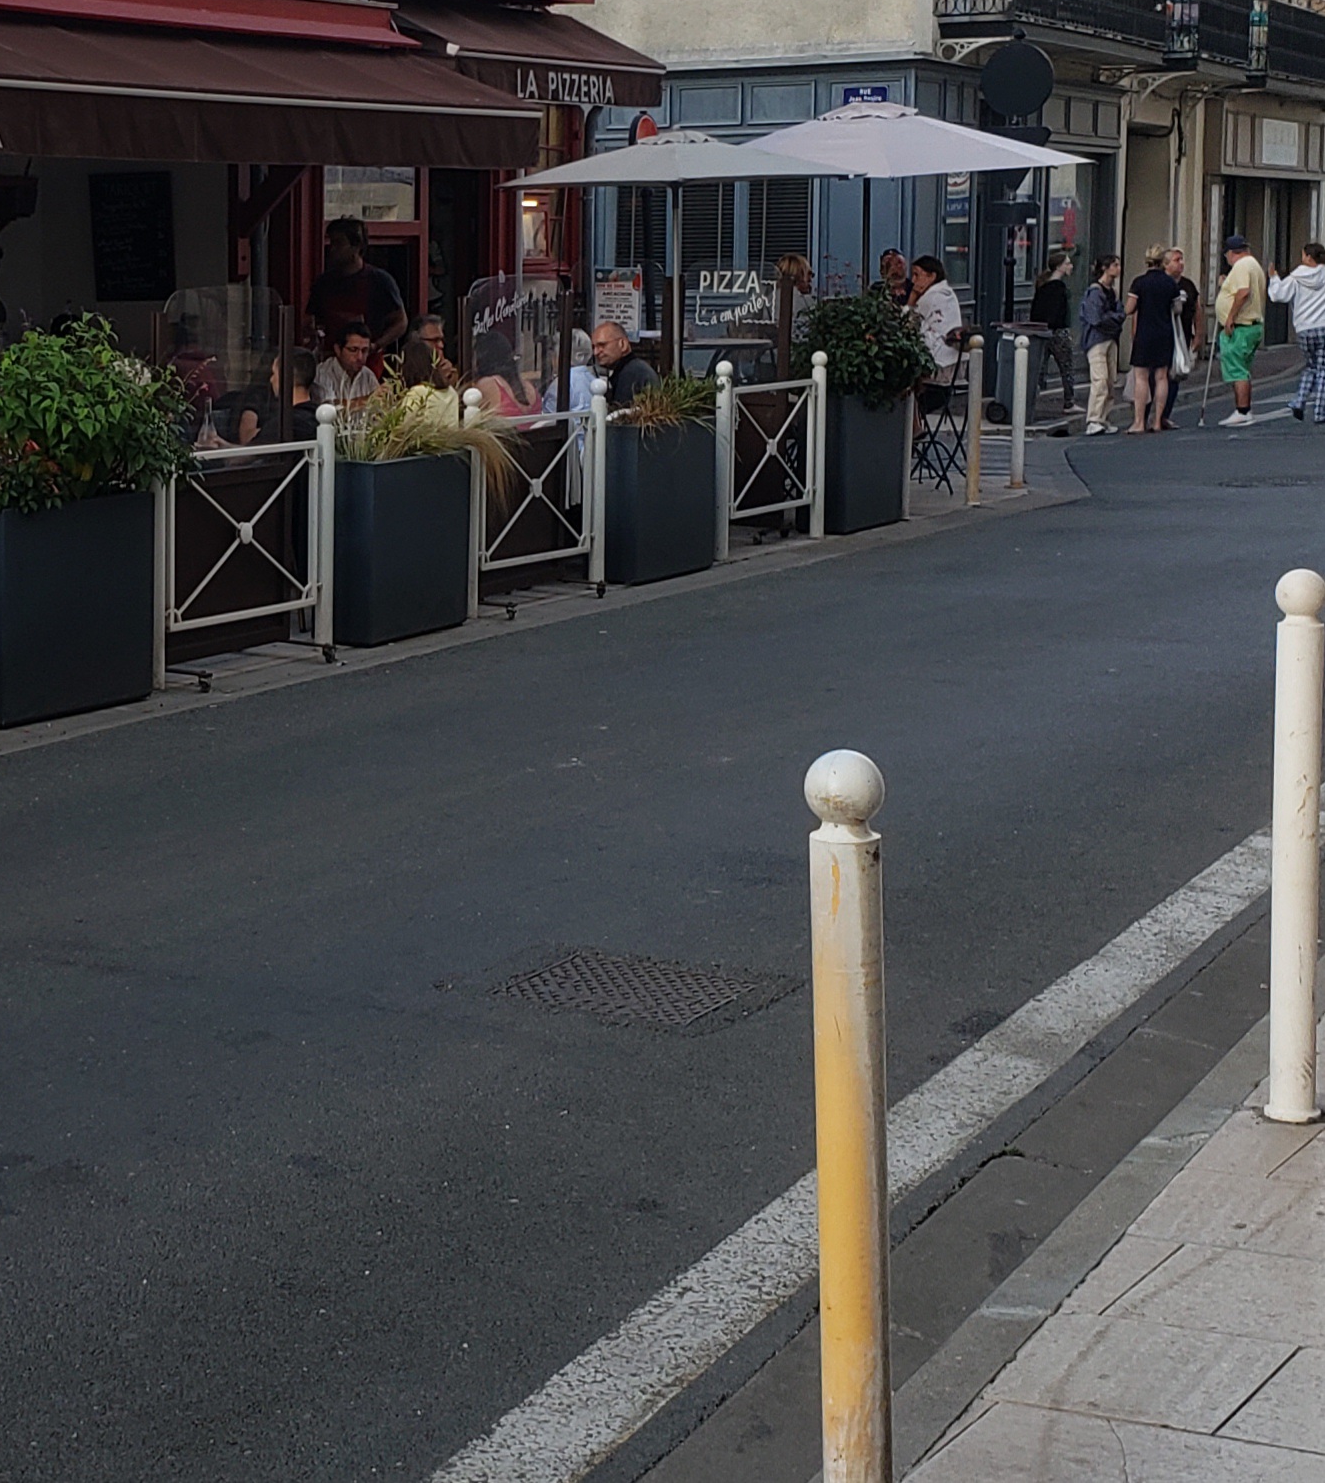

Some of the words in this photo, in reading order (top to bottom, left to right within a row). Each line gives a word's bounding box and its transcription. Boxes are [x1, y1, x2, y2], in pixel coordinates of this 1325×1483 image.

[517, 67, 538, 99] LA
[548, 71, 614, 104] PIZZERIA
[699, 270, 760, 293] PIZZA
